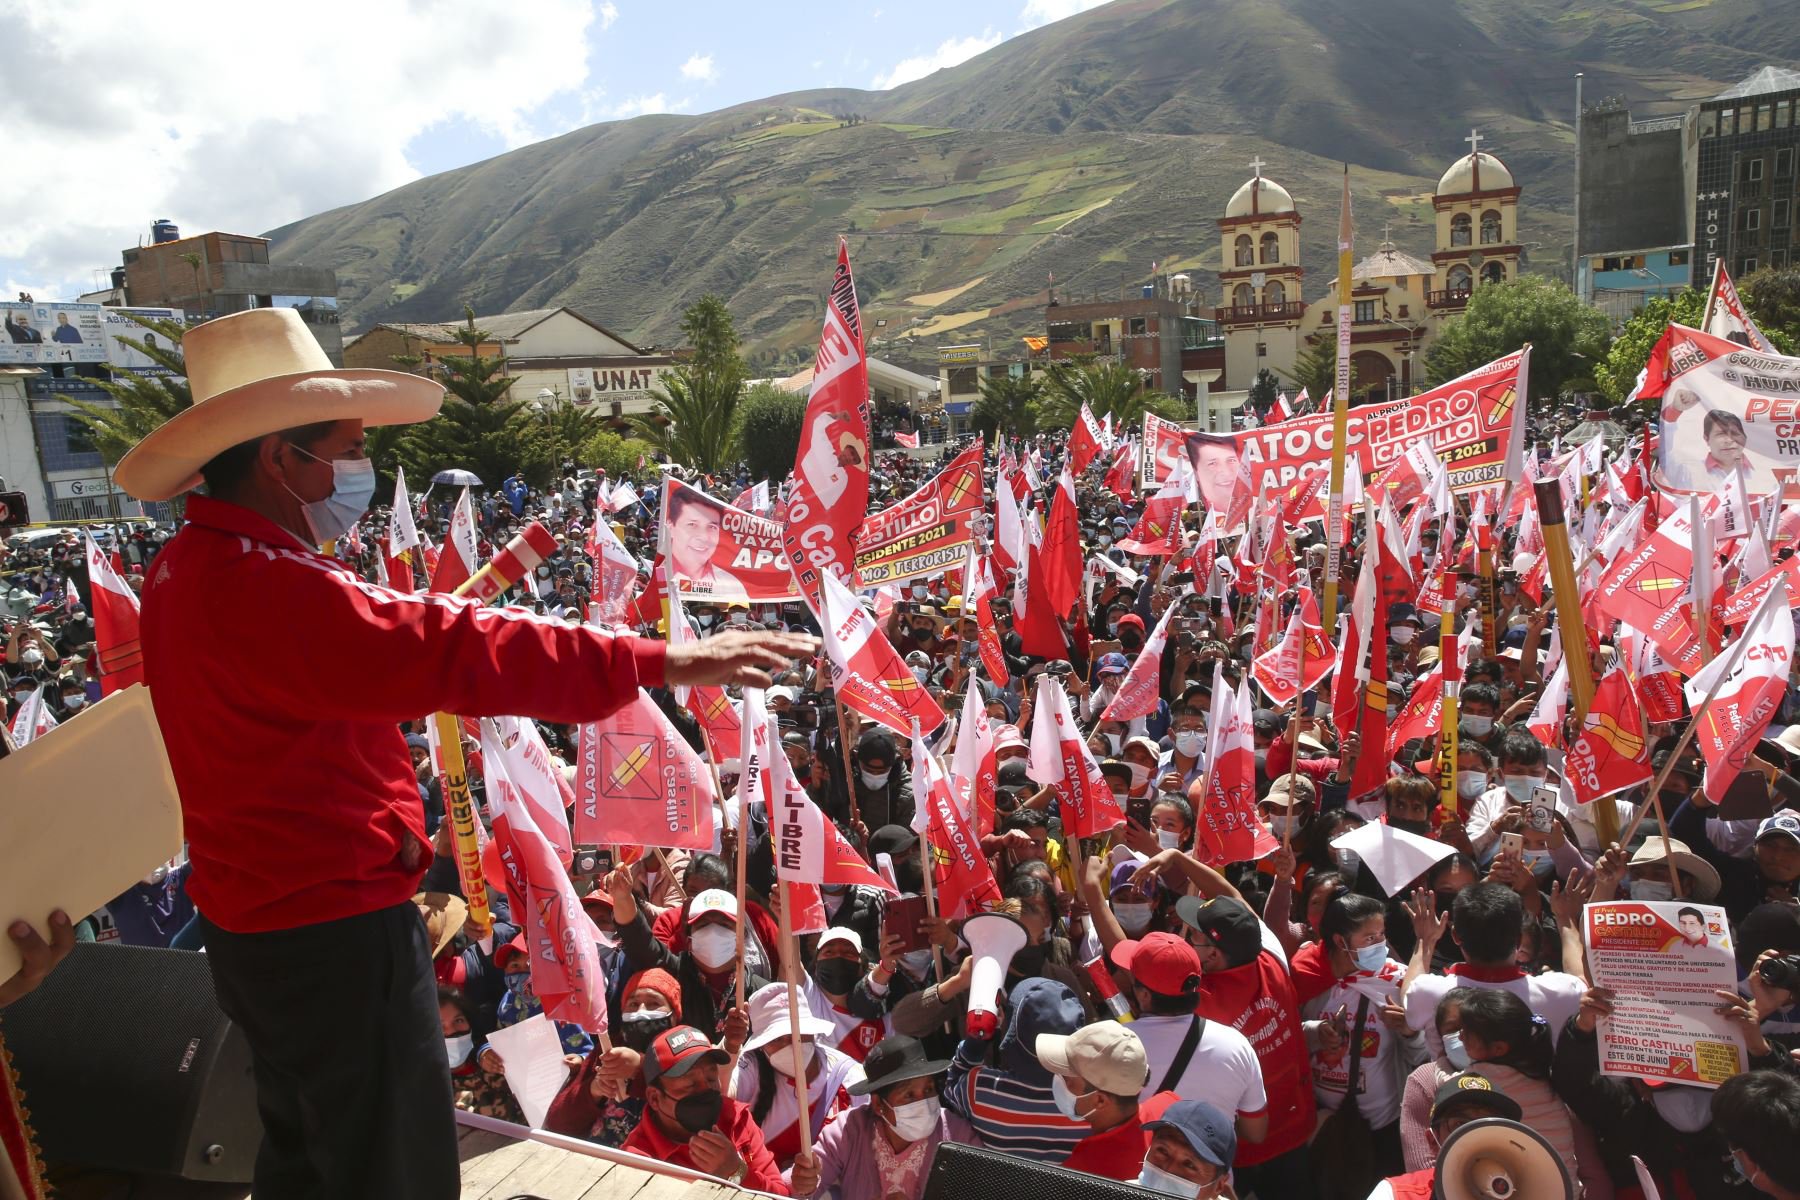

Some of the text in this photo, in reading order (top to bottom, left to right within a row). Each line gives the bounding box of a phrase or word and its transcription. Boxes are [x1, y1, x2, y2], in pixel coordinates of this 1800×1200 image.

[1706, 209, 1718, 277] HOTEL
[1338, 312, 1350, 395] PERU LIBRE
[593, 369, 651, 391] UNAT
[1368, 390, 1477, 446] PEDRO
[1380, 401, 1411, 416] PROFE
[1455, 441, 1487, 461] 2021
[1292, 478, 1321, 516] TAYACAJA
[918, 524, 946, 546] 2021
[1164, 506, 1179, 548] TAYACAJA
[1329, 500, 1341, 577] PERU LIBRE
[692, 580, 713, 588] PERU
[848, 671, 881, 694] Pedro
[868, 702, 887, 713] 2021
[1656, 680, 1678, 714] Castillo
[1727, 702, 1743, 732] Pedro
[1713, 736, 1725, 751] 2021
[1440, 732, 1453, 792] LIBRE
[449, 769, 475, 837] LIBRE
[781, 793, 805, 871] LIBRE
[1205, 812, 1218, 833] 2021
[936, 797, 976, 872] TAYACAJA
[463, 851, 488, 909] PERU
[1594, 913, 1657, 926] PEDRO
[1594, 926, 1662, 937] CASTILLO
[1604, 1034, 1638, 1046] PEDRO
[1642, 1040, 1693, 1052] CASTILLO
[1610, 1044, 1653, 1054] PRESIDENTE
[1607, 1063, 1632, 1072] MARCA
[1608, 1052, 1668, 1066] ESTE 06 DE JUNIO
